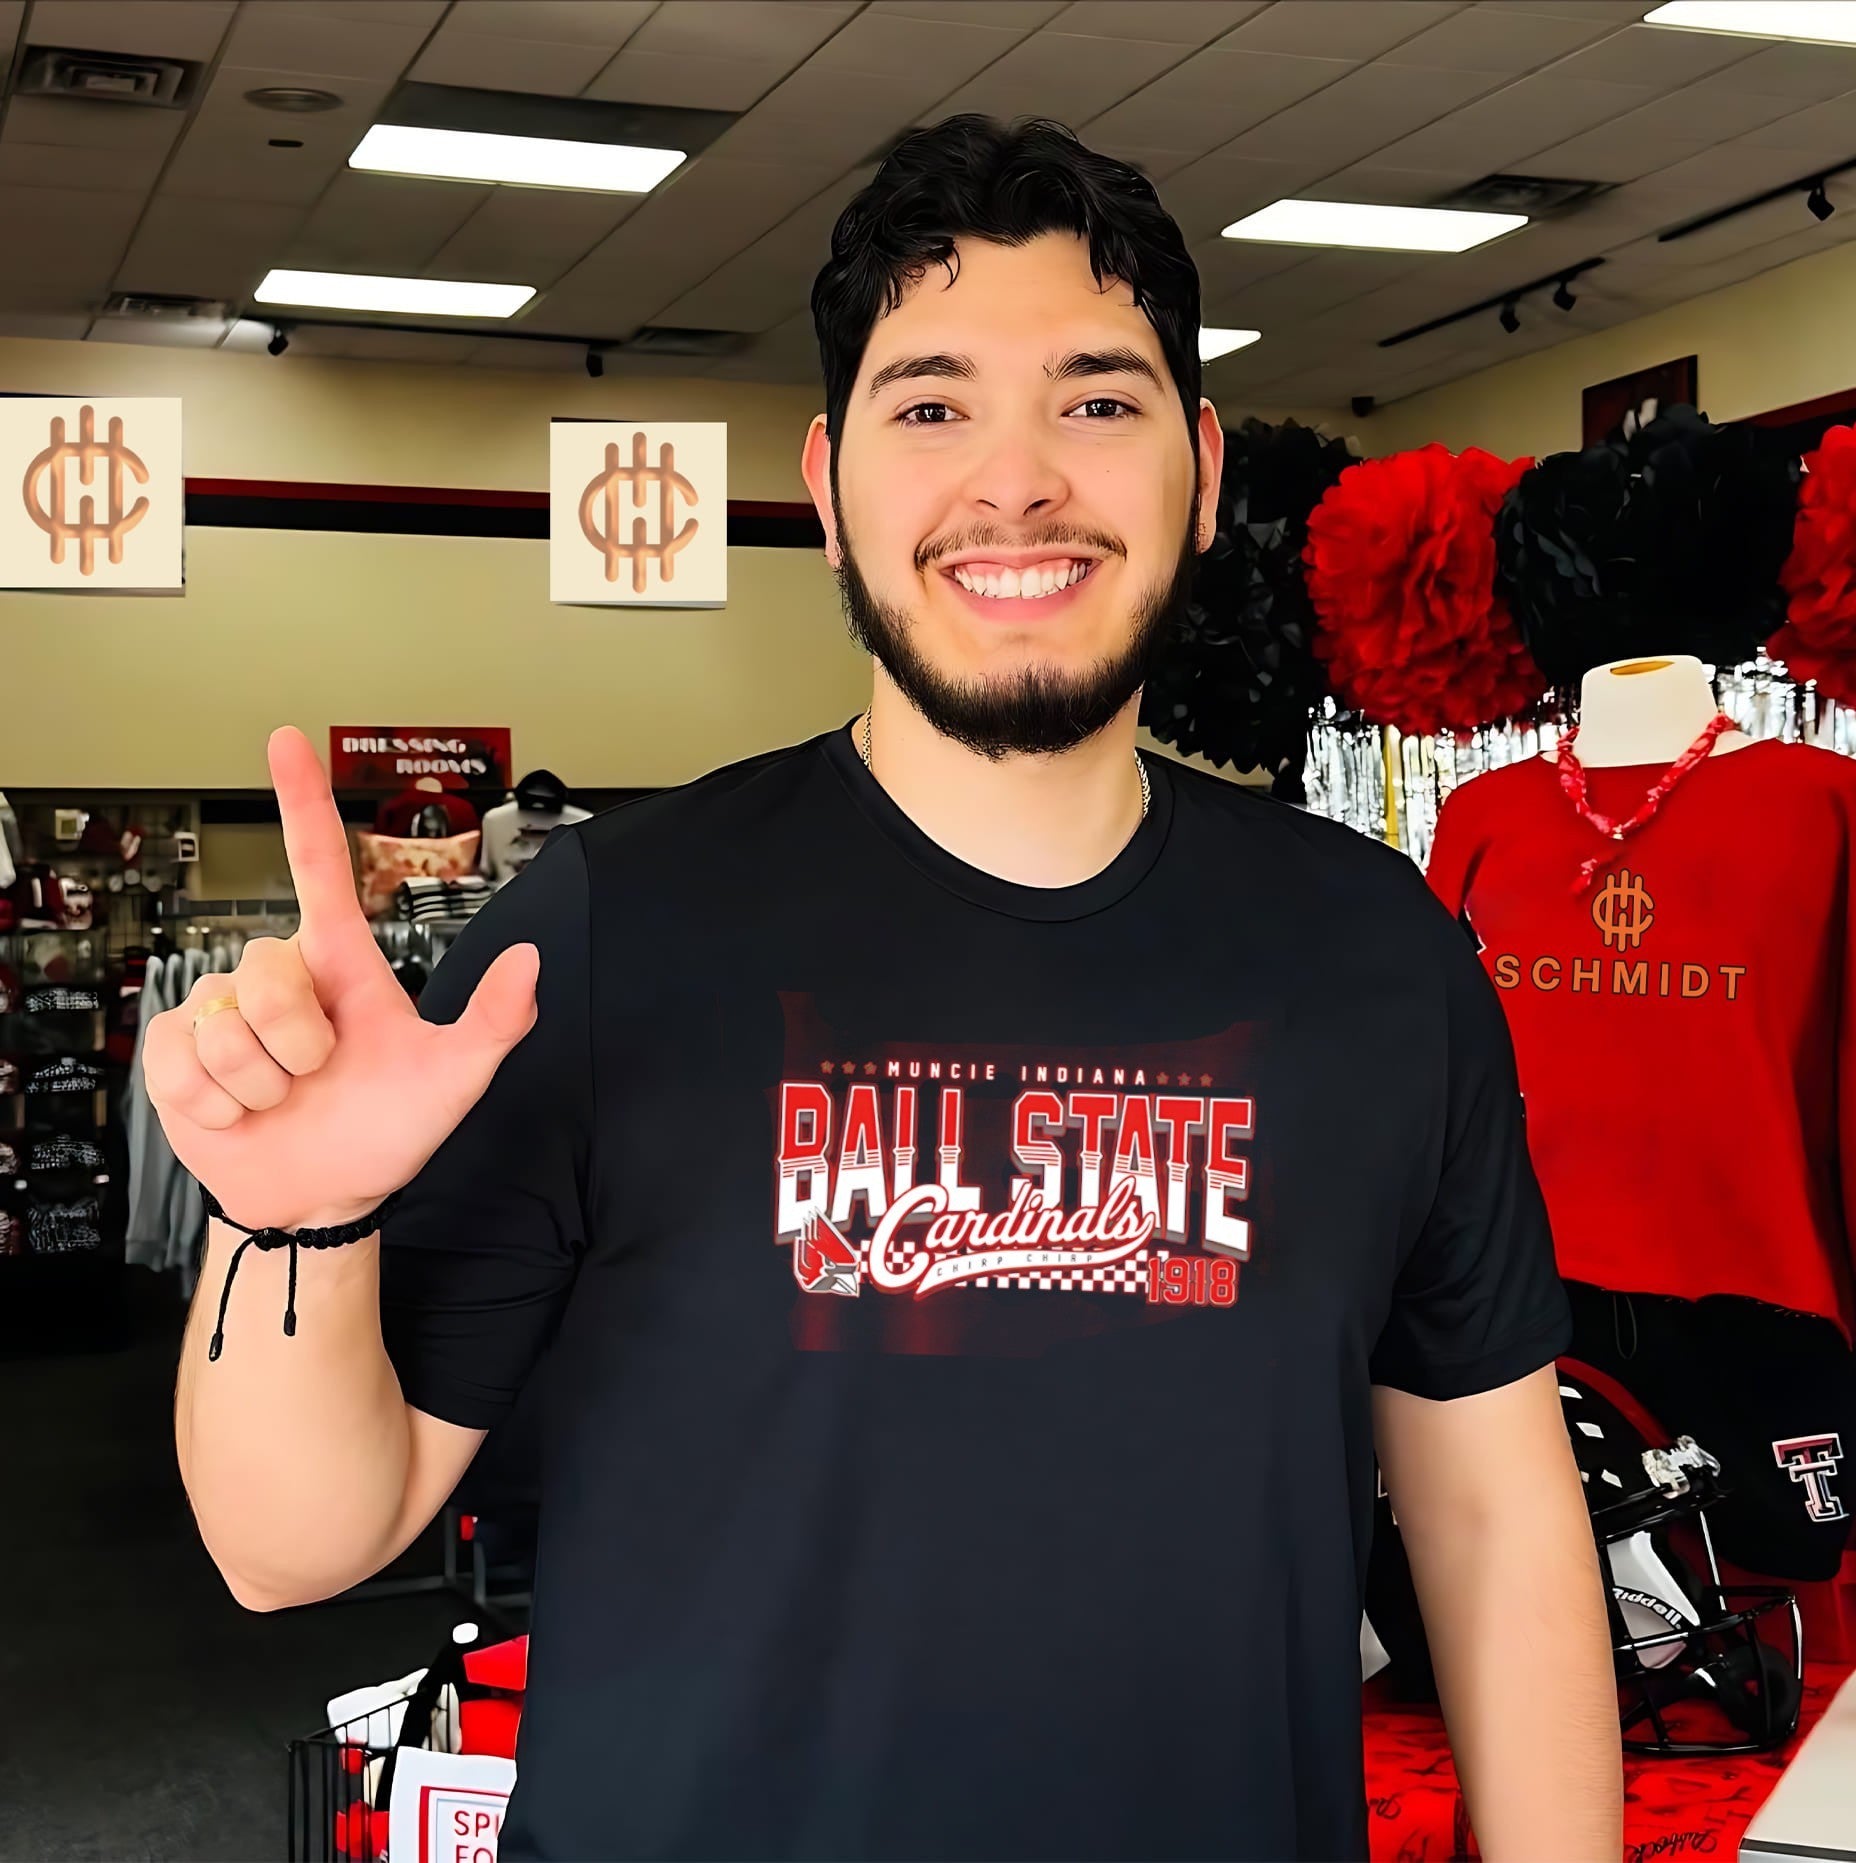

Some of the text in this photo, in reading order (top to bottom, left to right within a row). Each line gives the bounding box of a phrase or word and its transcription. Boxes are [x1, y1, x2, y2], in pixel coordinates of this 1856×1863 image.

[341, 737, 467, 754] DRESSING
[395, 758, 488, 776] ROOMS
[1494, 953, 1747, 1000] SCHMIDT
[887, 1061, 1146, 1086] MUNCIE INDIANA
[1012, 1090, 1255, 1256] STATE
[869, 1175, 1157, 1290] Cardinals
[936, 1253, 1093, 1277] CHIRP CHIRP
[1145, 1257, 1238, 1305] 1918
